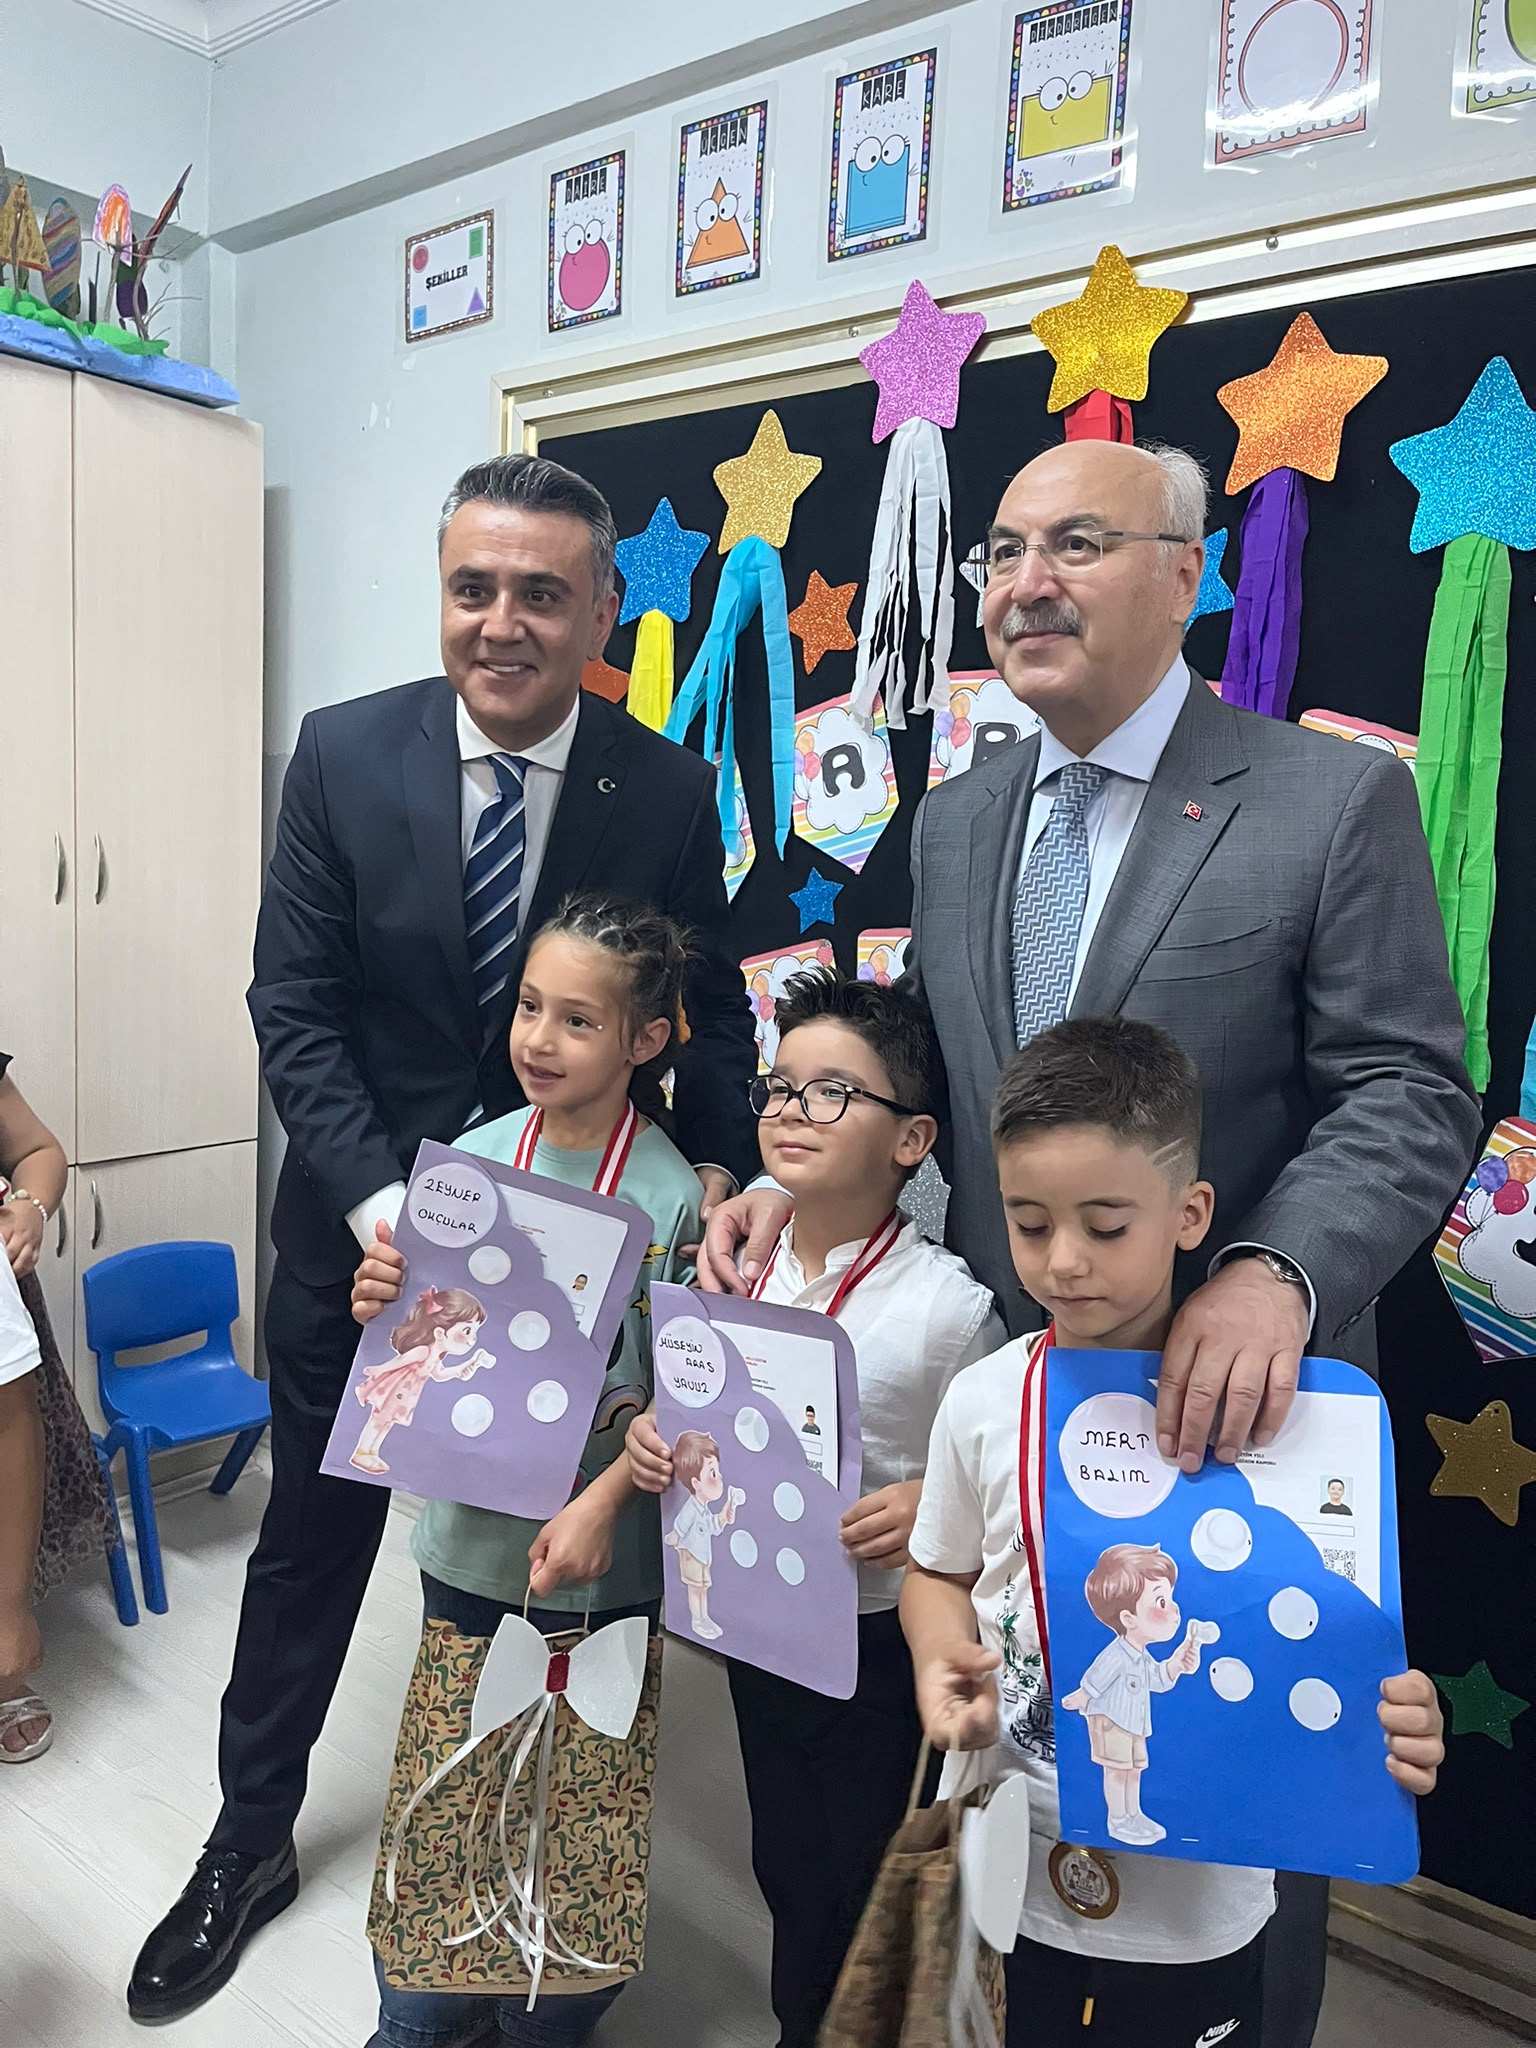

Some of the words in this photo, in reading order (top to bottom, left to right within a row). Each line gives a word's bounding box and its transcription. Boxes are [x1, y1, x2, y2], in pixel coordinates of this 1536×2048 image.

[863, 79, 904, 106] KARE
[821, 743, 866, 798] A
[417, 1208, 477, 1235] OKÇULAR
[1080, 1430, 1150, 1451] MERT
[1205, 2018, 1236, 2038] NIKE
